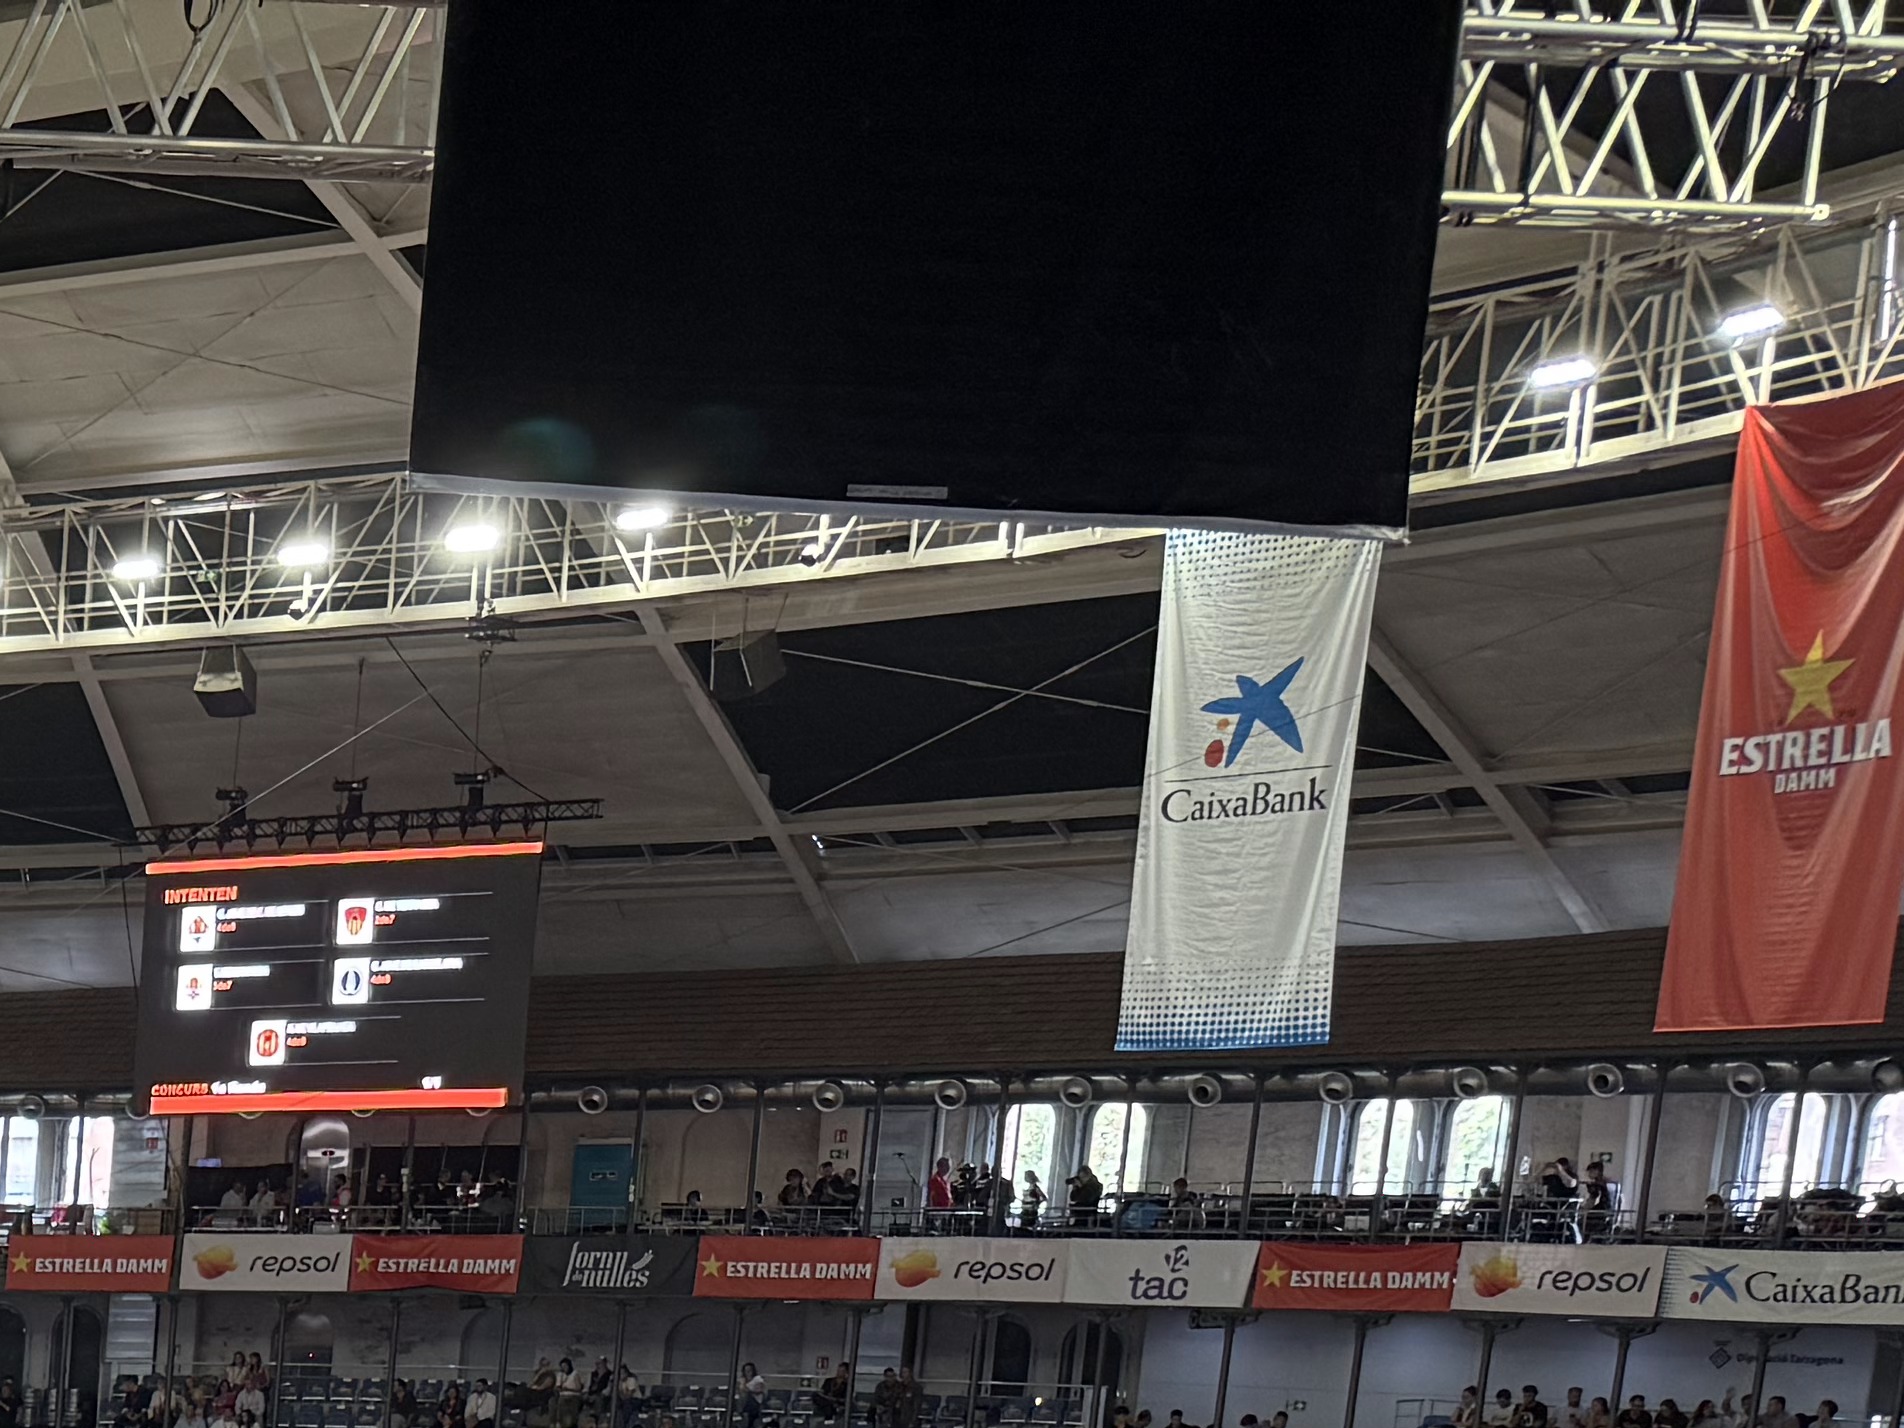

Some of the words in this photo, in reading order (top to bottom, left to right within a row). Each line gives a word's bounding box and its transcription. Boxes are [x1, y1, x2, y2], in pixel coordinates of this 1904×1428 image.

[1719, 718, 1893, 777] ESTRELLA
[1774, 766, 1836, 794] DAMM
[1160, 777, 1328, 825] CaixaBank
[165, 886, 238, 904] INTENTEN
[35, 1257, 113, 1273] ESTRELLA
[116, 1258, 168, 1274] DAMM
[249, 1251, 341, 1276] repsol
[377, 1257, 459, 1273] ESTRELLA
[461, 1258, 517, 1275] DAMM
[727, 1260, 810, 1279] ESTRELLA
[814, 1262, 872, 1280] DAMM
[953, 1258, 1056, 1284] repsol
[1129, 1268, 1188, 1299] tac
[1290, 1270, 1382, 1289] ESTRELLA
[1386, 1270, 1450, 1289] DAMM
[1536, 1267, 1651, 1297] repsol
[1745, 1271, 1904, 1304] CaixaBan
